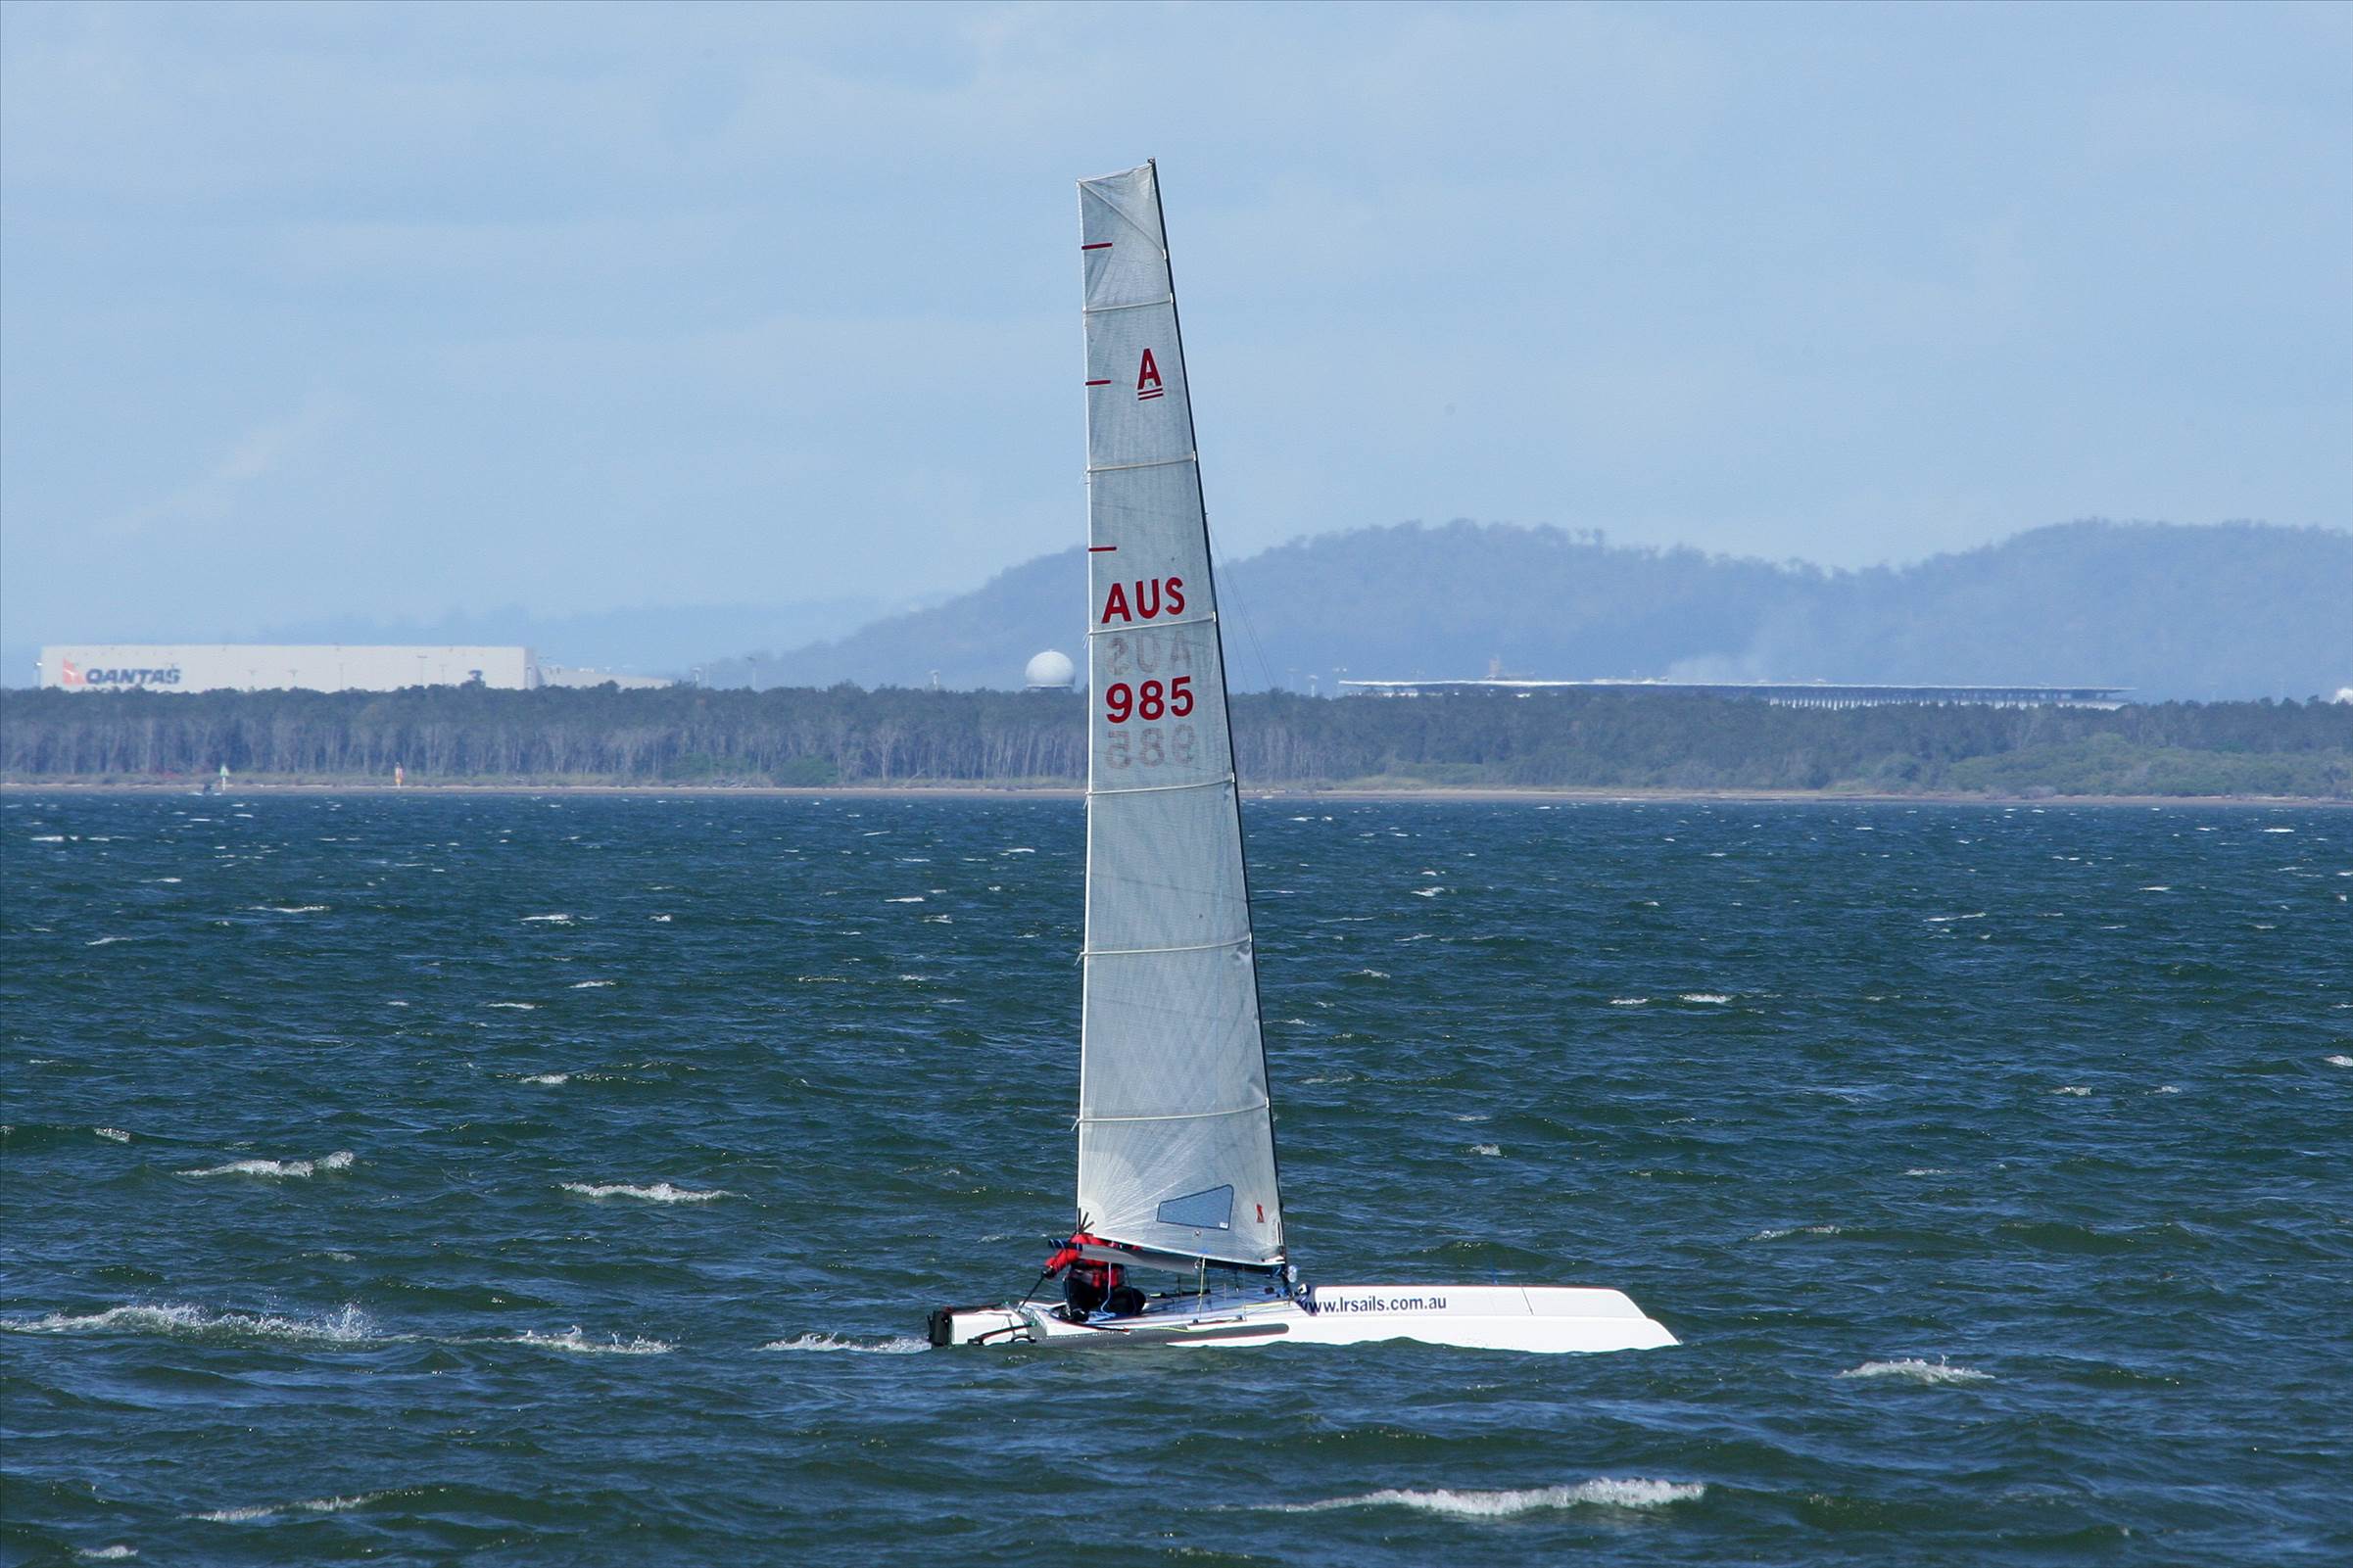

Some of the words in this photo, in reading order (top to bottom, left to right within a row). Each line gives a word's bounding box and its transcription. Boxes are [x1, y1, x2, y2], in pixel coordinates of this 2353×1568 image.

[1137, 348, 1162, 390] A
[1100, 576, 1186, 624] AUS
[85, 668, 181, 686] QANTAS
[1105, 675, 1194, 724] 985
